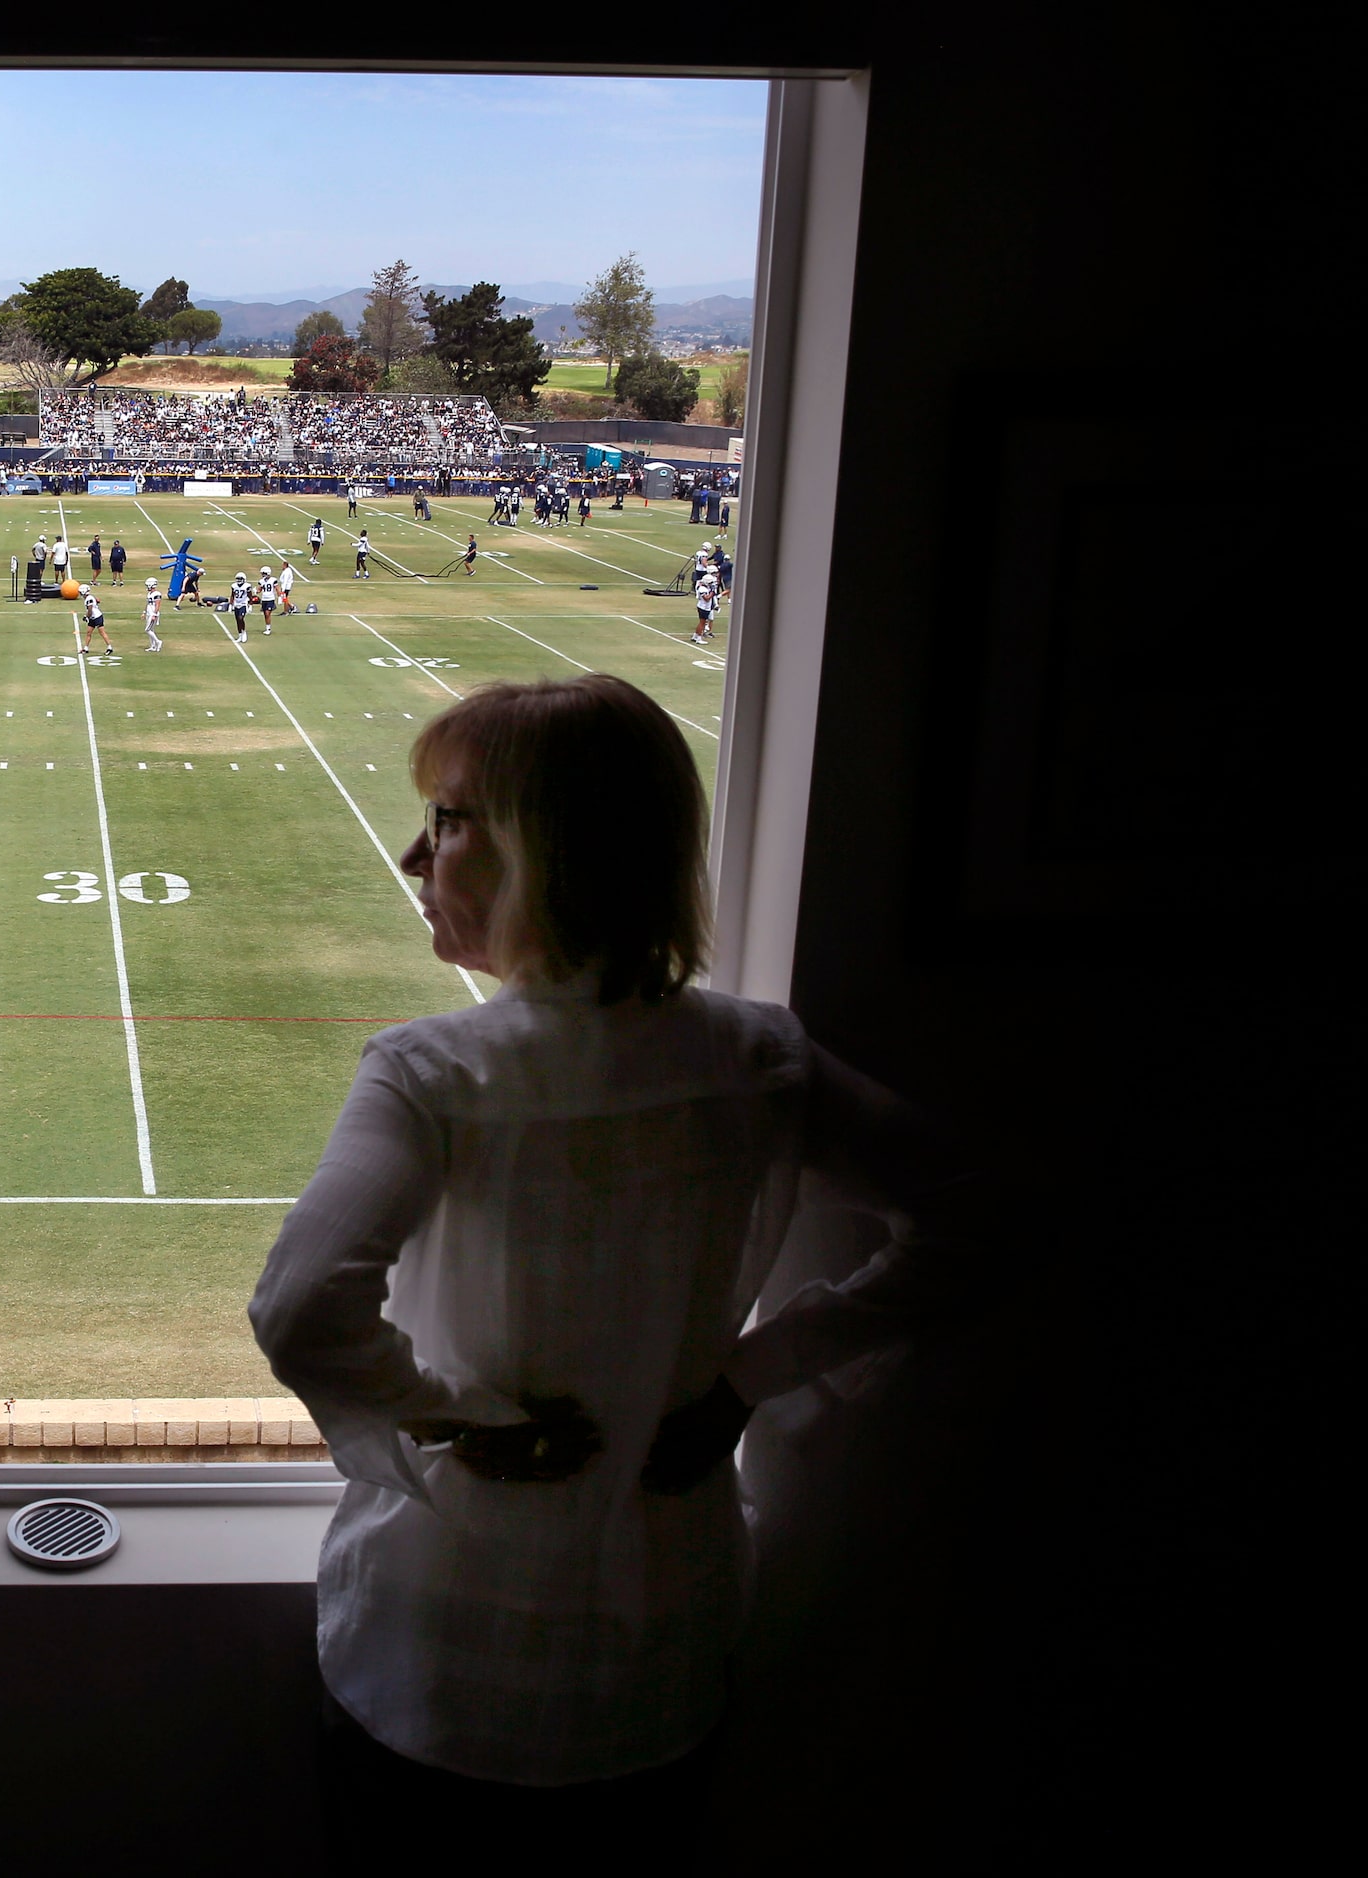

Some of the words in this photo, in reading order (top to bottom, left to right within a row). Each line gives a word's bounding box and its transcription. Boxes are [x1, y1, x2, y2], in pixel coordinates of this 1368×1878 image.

[354, 486, 373, 498] Lite
[36, 655, 123, 666] 30
[367, 656, 461, 669] 20
[35, 870, 192, 904] 30
